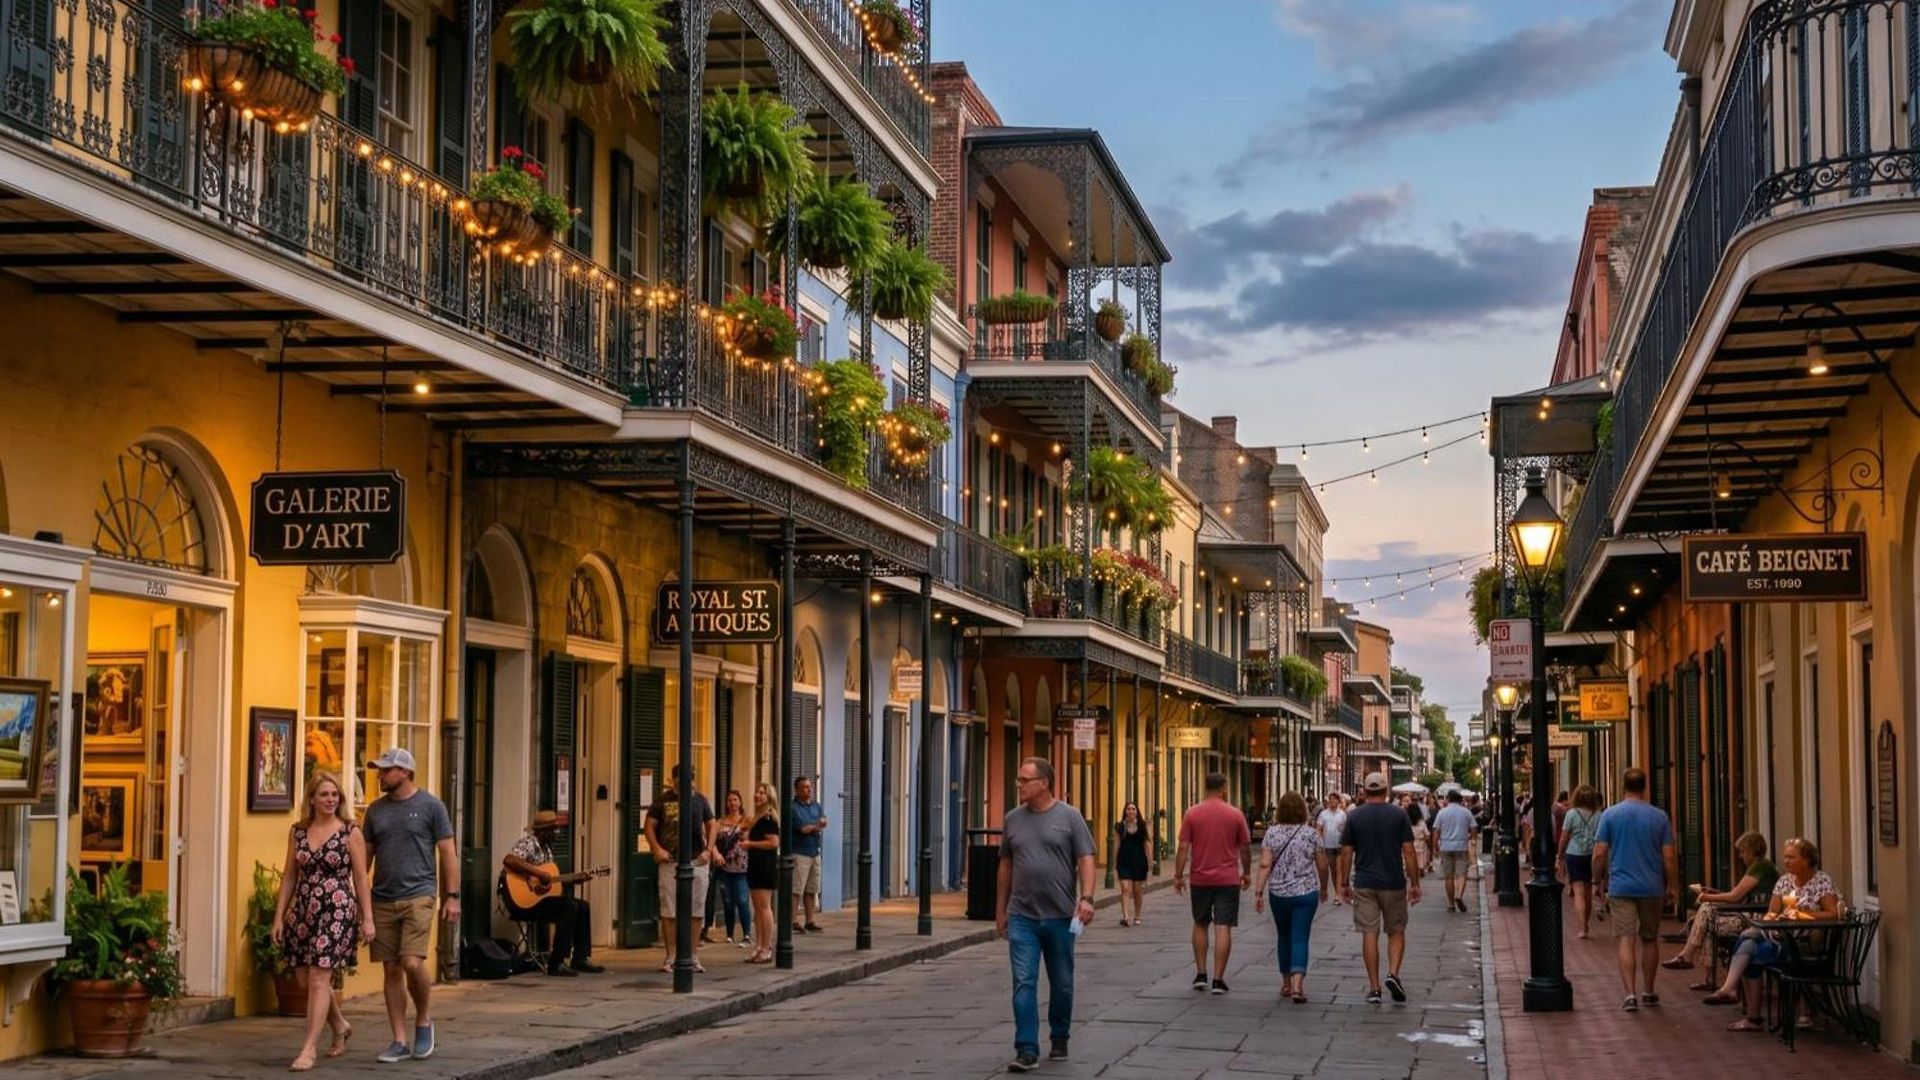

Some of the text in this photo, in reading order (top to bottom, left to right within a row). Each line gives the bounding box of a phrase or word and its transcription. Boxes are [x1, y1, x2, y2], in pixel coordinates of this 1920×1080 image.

[265, 486, 391, 514] GALERIE
[282, 522, 370, 549] D'ART
[1696, 544, 1852, 573] CAFÉ BEIGNET
[1747, 578, 1802, 589] EST. 1990
[741, 589, 769, 609] ST.
[666, 612, 771, 635] ATIQUES
[1493, 626, 1509, 640] NO
